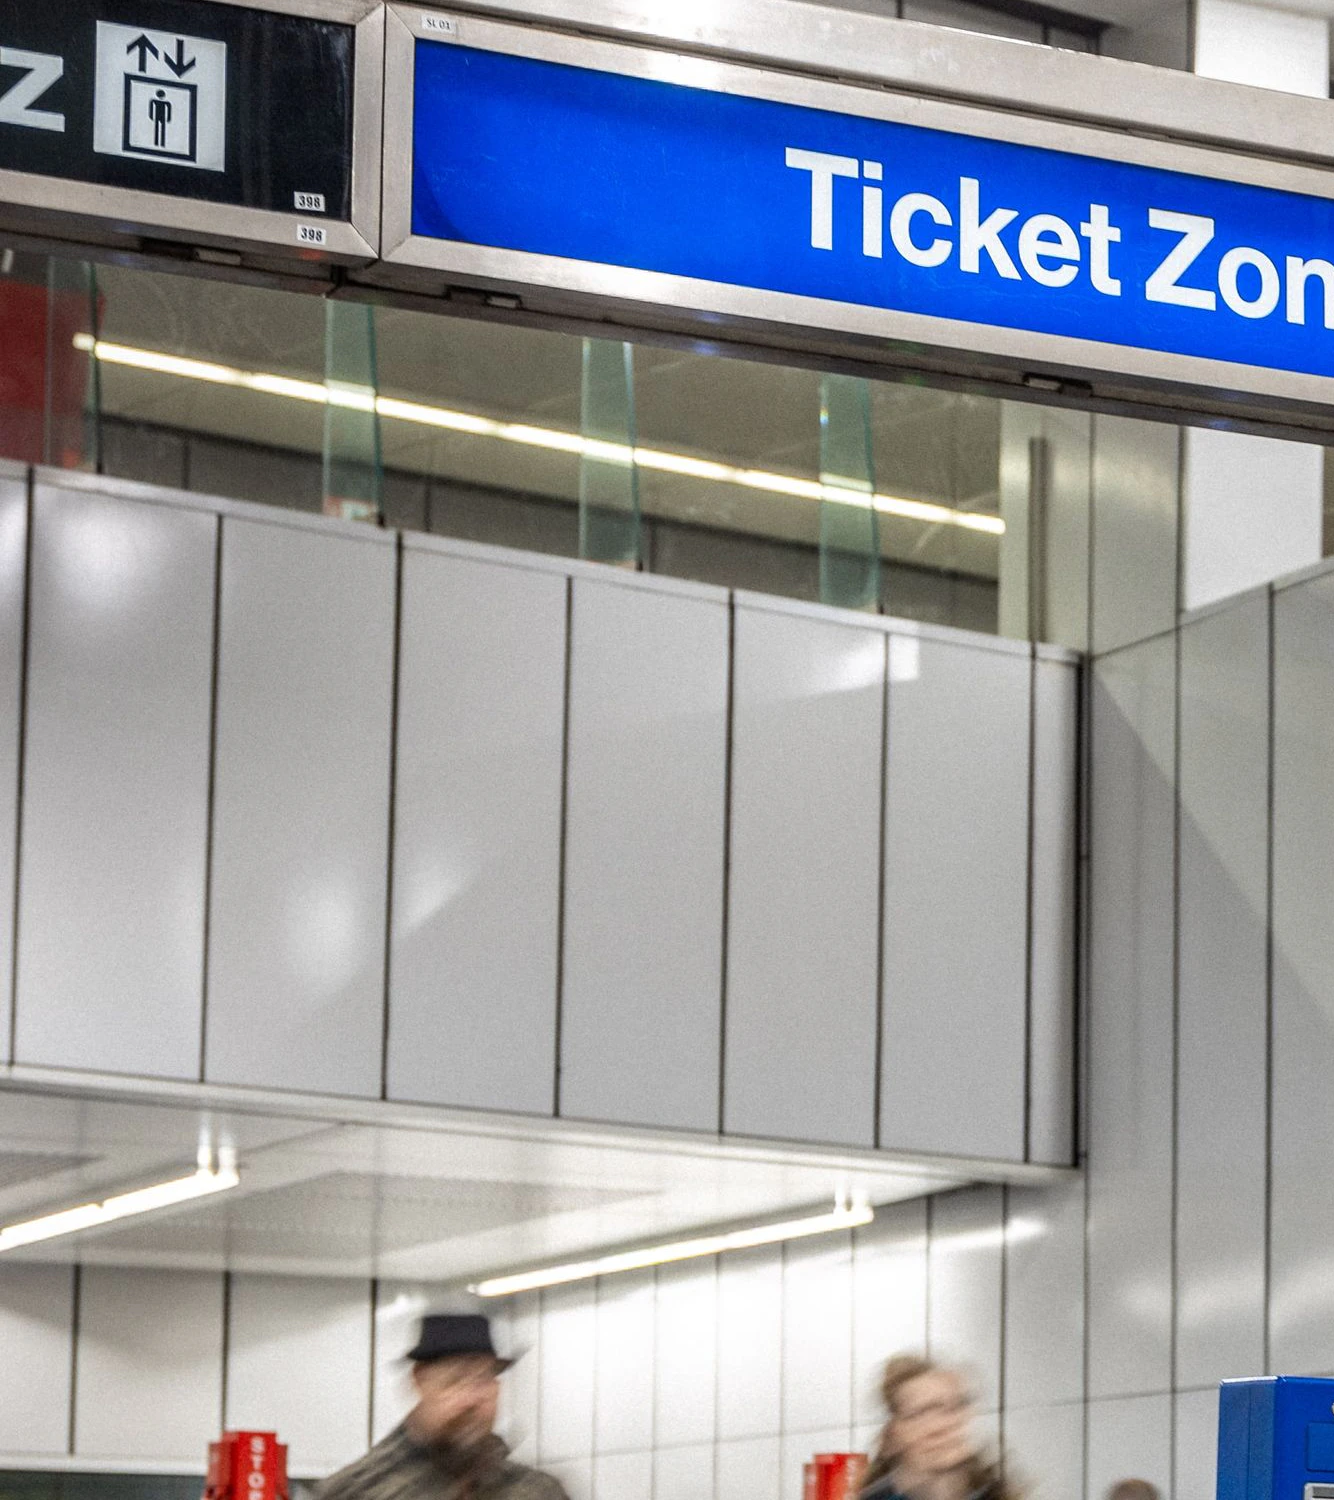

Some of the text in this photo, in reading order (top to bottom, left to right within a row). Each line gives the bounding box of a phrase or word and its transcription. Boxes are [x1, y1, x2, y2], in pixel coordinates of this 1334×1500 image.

[299, 195, 320, 209] 398
[785, 147, 1121, 296] Ticket
[301, 227, 322, 242] 398
